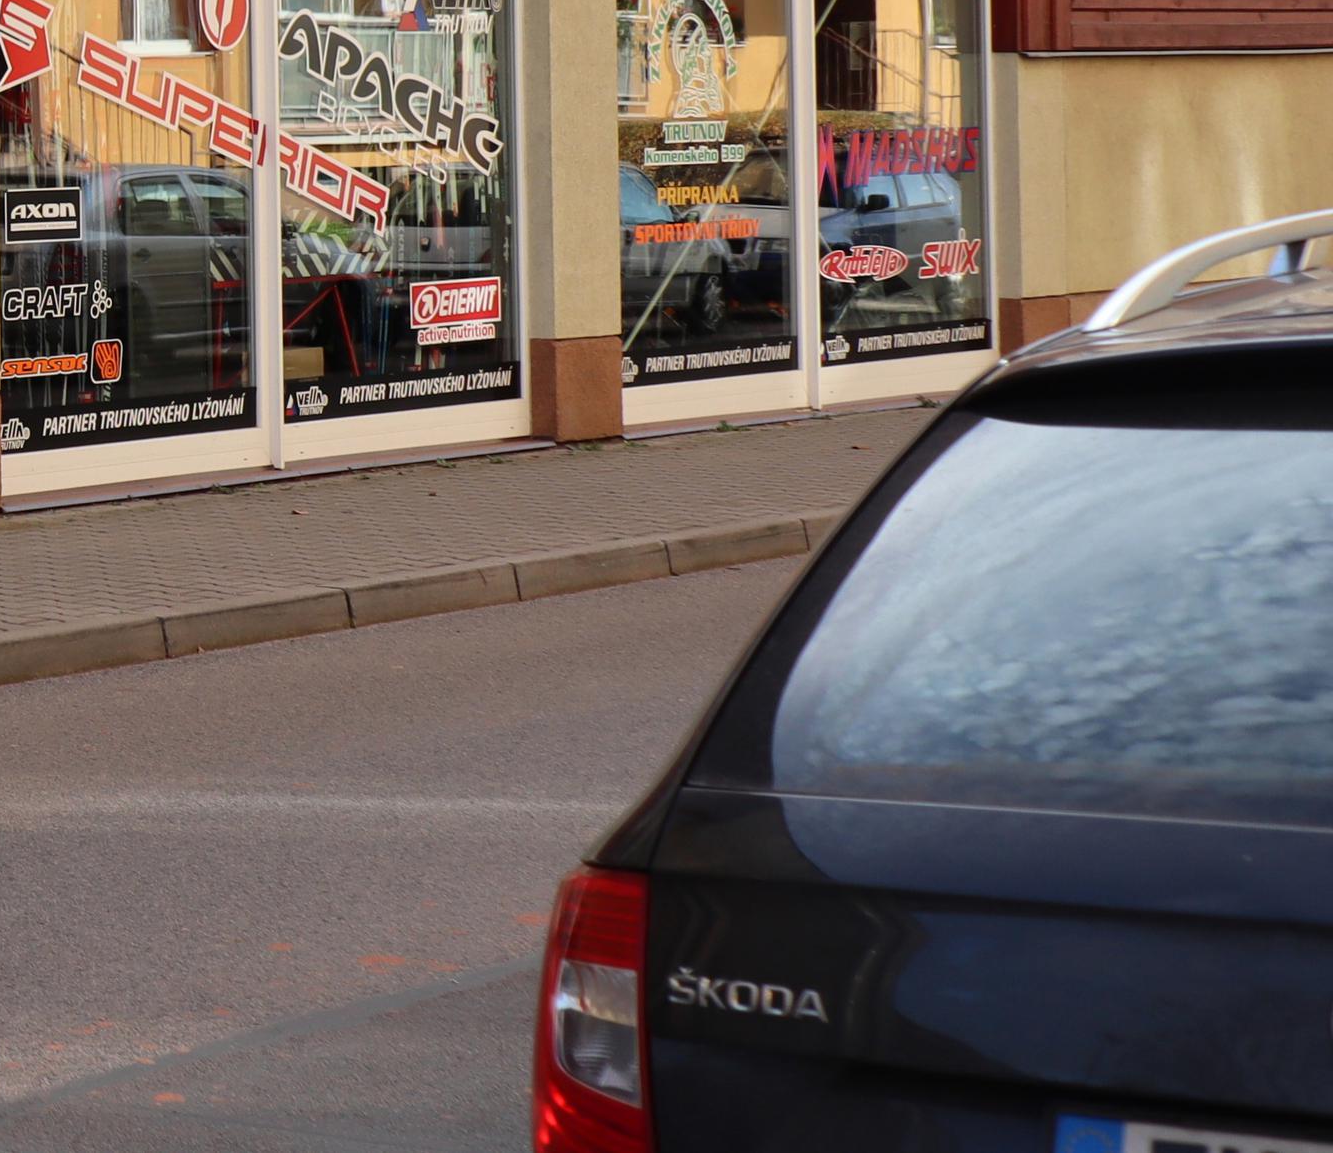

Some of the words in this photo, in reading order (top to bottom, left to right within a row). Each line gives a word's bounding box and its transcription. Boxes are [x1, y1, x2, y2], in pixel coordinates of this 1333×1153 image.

[434, 13, 494, 35] TRUTNOV
[317, 90, 449, 184] BICYCLES
[664, 120, 728, 144] TRUTNOV
[644, 146, 719, 166] Komenského
[721, 144, 746, 162] 399
[844, 127, 981, 188] MADSHUS
[10, 202, 76, 219] AXON
[919, 239, 981, 279] SWIX
[3, 284, 88, 321] CRAFT
[438, 284, 498, 316] ENERVIT
[418, 328, 448, 345] active
[449, 324, 495, 342] nutrition
[857, 334, 892, 353] PARTNER
[645, 355, 685, 373] PARTNER
[686, 346, 752, 370] TRUTNOVSKÉHO
[752, 341, 793, 362] LYŽOVÁNÍ
[339, 385, 386, 404] PARTNER
[388, 373, 465, 398] TRUTNOVSKÉHO
[466, 366, 514, 390] LYŽOVÁNÍ
[42, 413, 97, 437] PARTNER
[99, 401, 190, 430] TRUTNOVSKÉHO
[191, 393, 245, 423] LYŽOVÁNÍ
[668, 967, 829, 1024] ŠKODA
